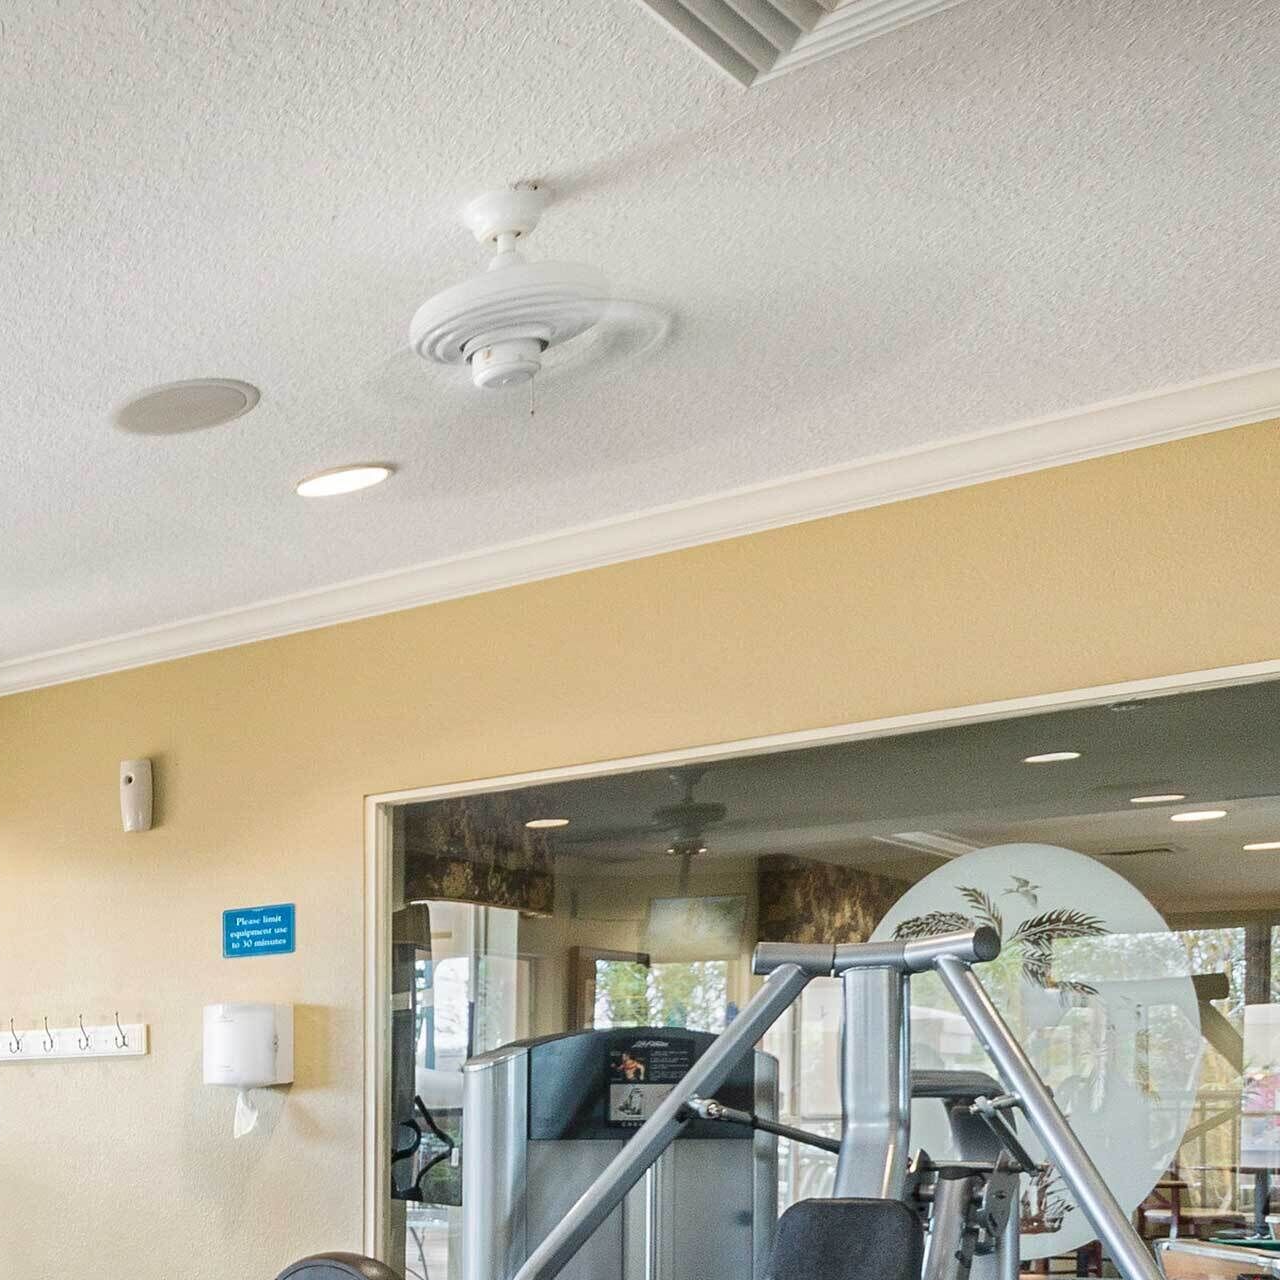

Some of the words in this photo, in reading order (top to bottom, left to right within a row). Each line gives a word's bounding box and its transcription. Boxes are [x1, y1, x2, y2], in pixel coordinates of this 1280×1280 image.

[236, 917, 260, 926] Please
[263, 915, 282, 923] limit
[230, 928, 272, 939] equipment
[242, 939, 253, 947] 30
[254, 938, 287, 947] minutes
